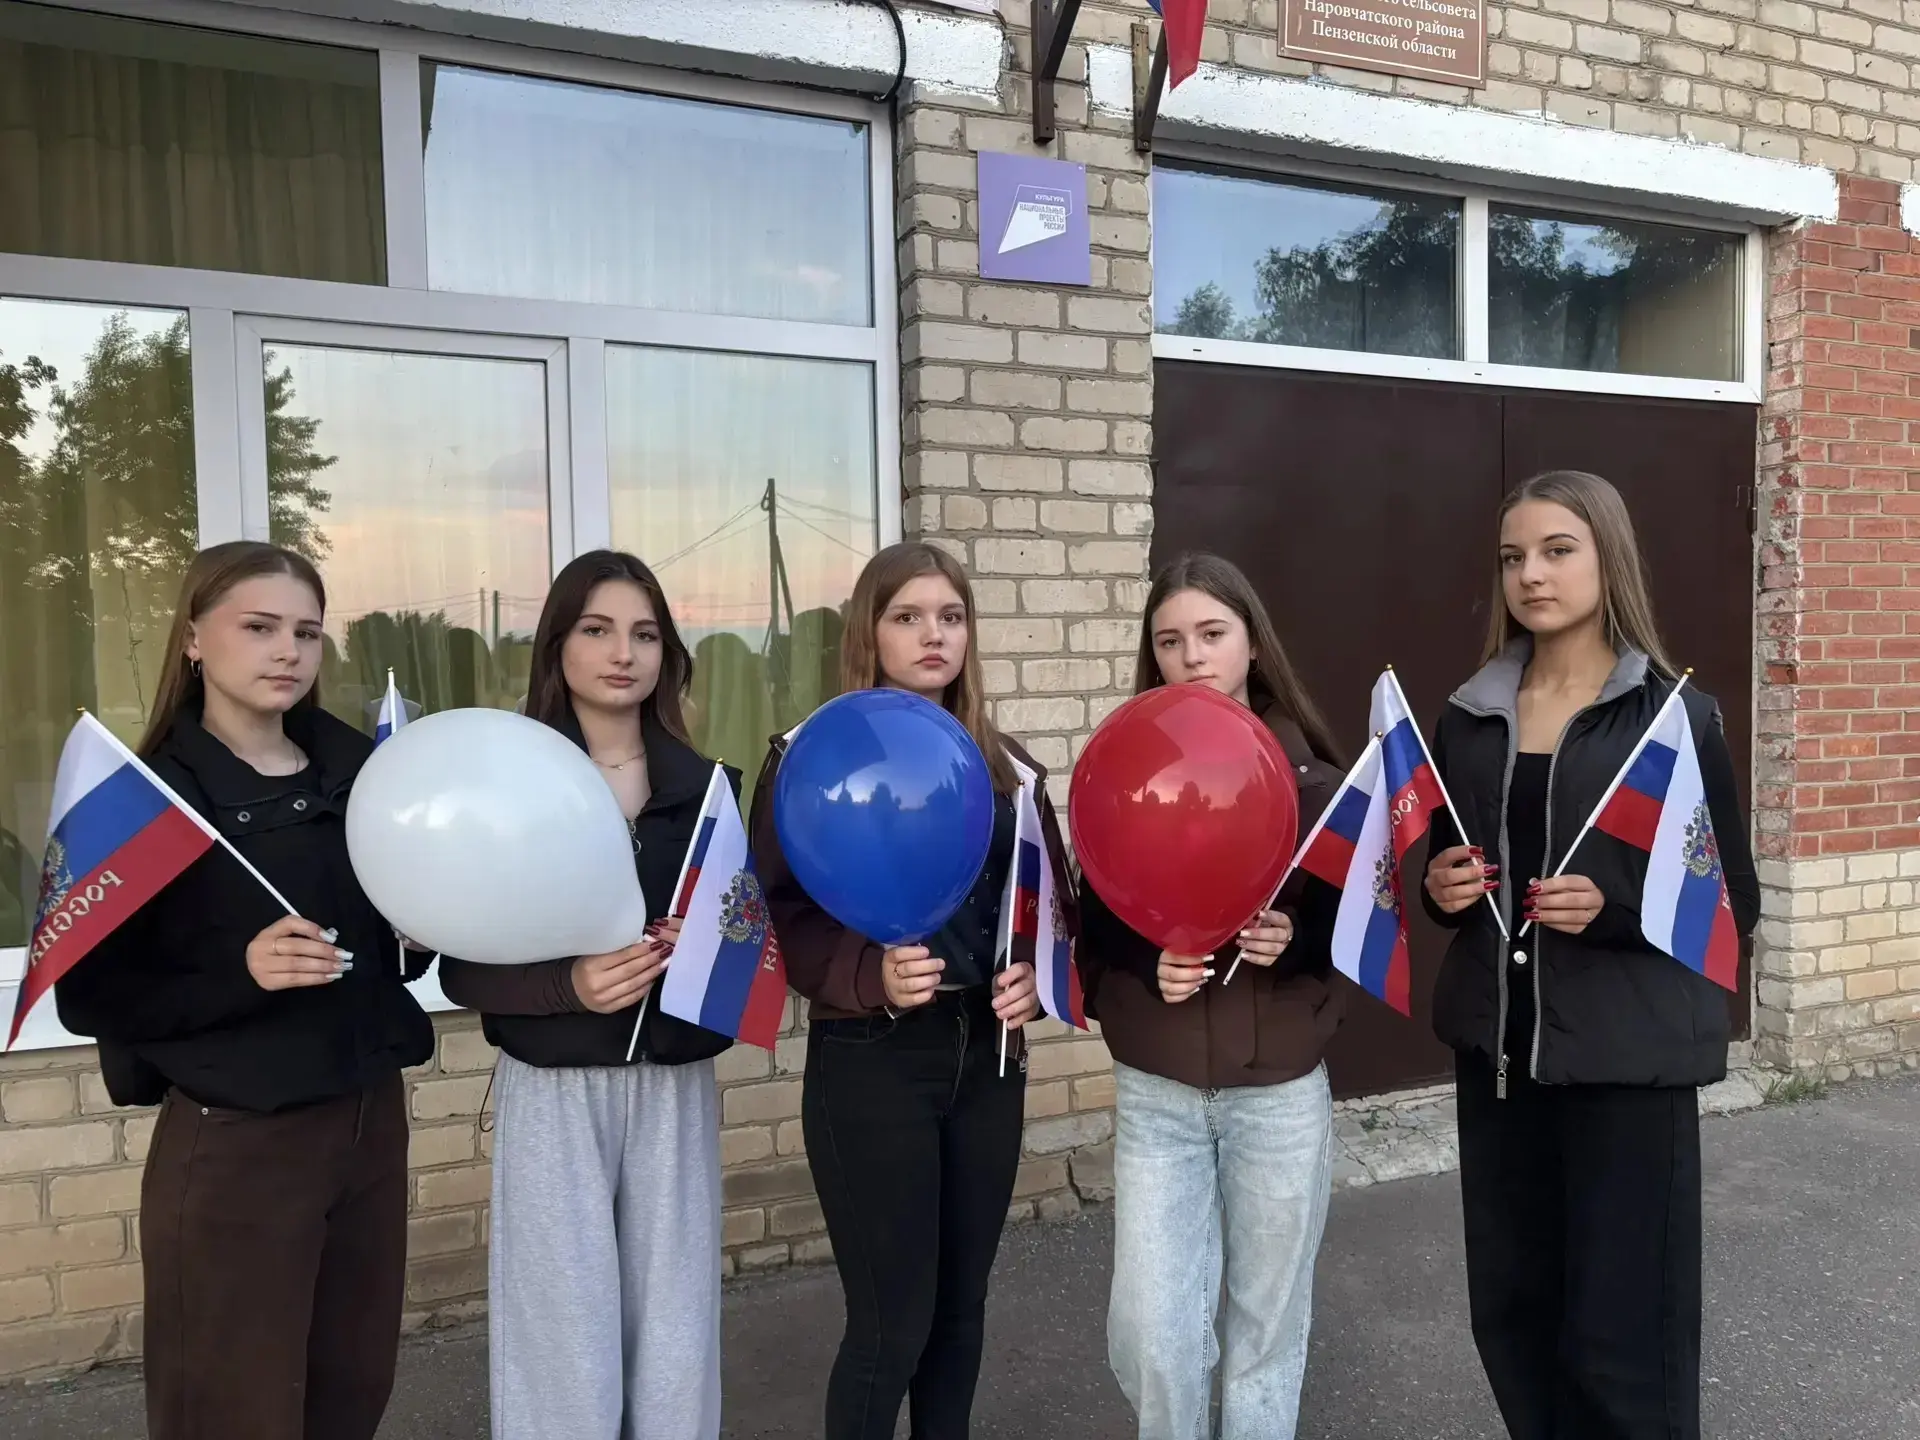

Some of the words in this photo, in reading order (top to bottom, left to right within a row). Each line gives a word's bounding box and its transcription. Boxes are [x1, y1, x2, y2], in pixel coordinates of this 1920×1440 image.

[1403, 0, 1476, 19] сельсовета
[1304, 0, 1412, 29] Наровчатского
[1416, 19, 1465, 39] района
[1312, 19, 1399, 48] Пензенской
[1401, 37, 1457, 60] области
[1035, 194, 1064, 202] КУЛЬТУРА
[1019, 203, 1064, 214] НАЦИОНАЛЬНЫЕ
[1039, 213, 1064, 222] ПРОЕКТЫ
[1043, 221, 1064, 230] РОССИИ
